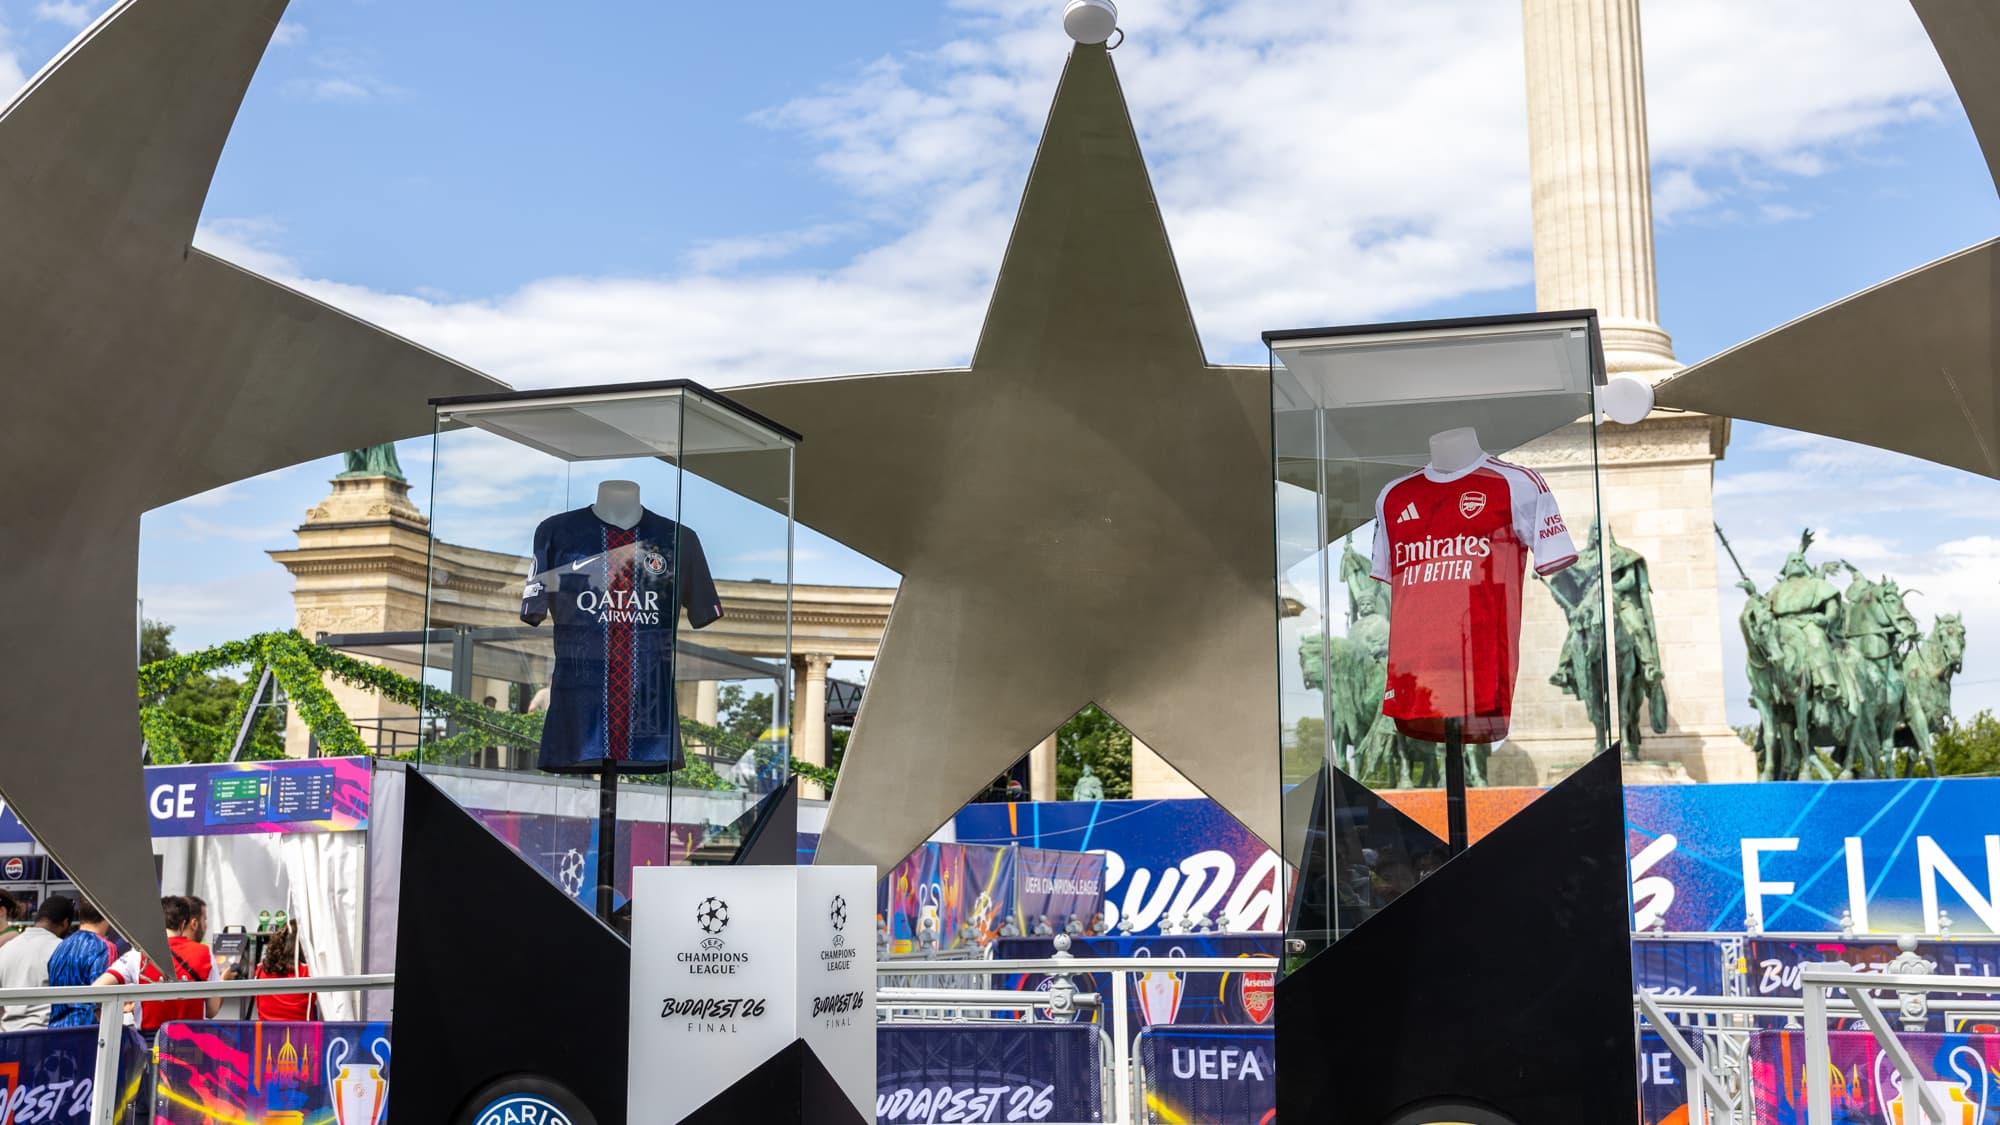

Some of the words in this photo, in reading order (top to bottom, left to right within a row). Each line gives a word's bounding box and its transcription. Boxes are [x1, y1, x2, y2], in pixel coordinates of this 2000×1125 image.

[1395, 533, 1491, 567] Emirates
[1402, 564, 1421, 587] FLY
[1423, 560, 1473, 583] BETTER
[576, 590, 659, 614] QATAR
[598, 611, 659, 625] AIRWAYS
[150, 784, 197, 820] GE
[1741, 835, 2000, 934] FIN
[701, 938, 723, 950] UEFA
[820, 948, 856, 960] CHAMPIONS
[677, 952, 749, 962] CHAMPIONS
[827, 960, 851, 972] LEAGUE
[689, 964, 736, 974] LEAGUE
[661, 997, 742, 1020] BUDAPEST
[741, 998, 766, 1018] 26
[812, 992, 853, 1018] BUDAPEST
[852, 990, 864, 1011] 26
[687, 1022, 737, 1033] FINAL
[826, 1018, 852, 1030] FINAL
[1172, 1048, 1264, 1081] UEFA
[1006, 1084, 1055, 1122] 26
